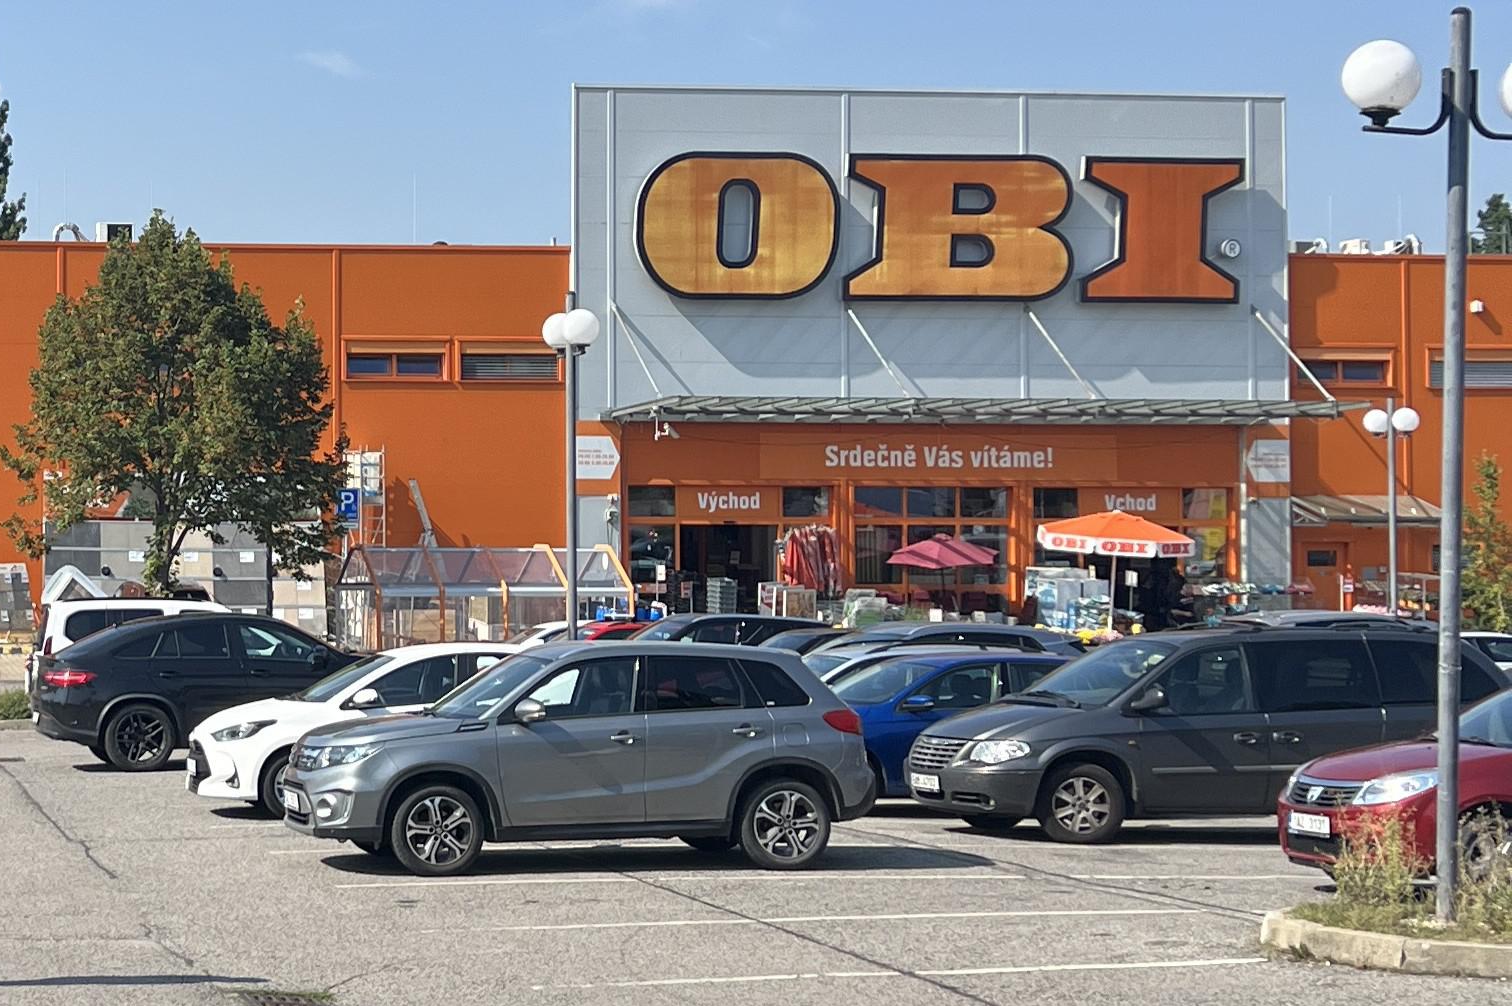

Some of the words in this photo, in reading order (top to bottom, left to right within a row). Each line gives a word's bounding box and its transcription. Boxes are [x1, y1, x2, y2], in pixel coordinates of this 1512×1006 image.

[635, 151, 1246, 304] OBI
[824, 444, 917, 468] Srdečně
[923, 445, 964, 468] Vás
[970, 444, 1054, 468] vítáme!
[697, 490, 761, 512] Východ
[1104, 493, 1157, 511] Vchod
[1051, 536, 1088, 549] OBI
[1101, 541, 1149, 554] OBI
[1161, 543, 1190, 555] OBI
